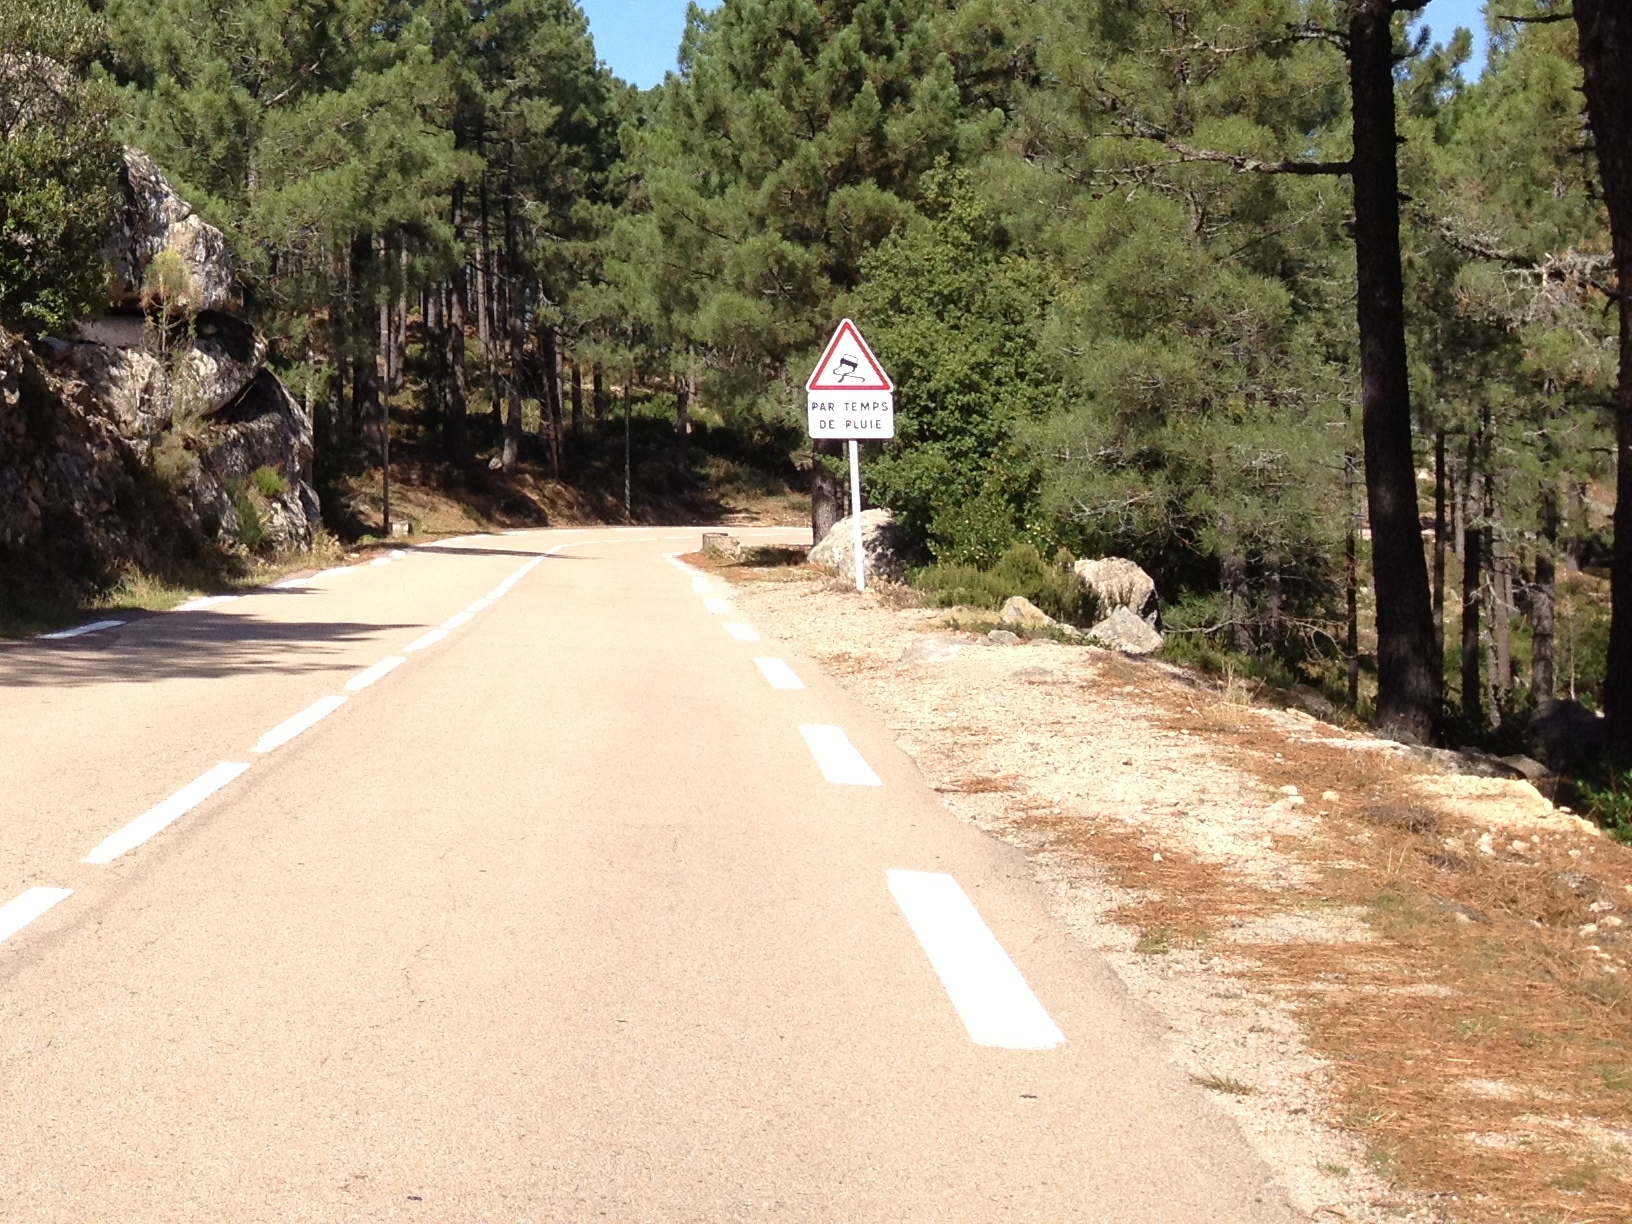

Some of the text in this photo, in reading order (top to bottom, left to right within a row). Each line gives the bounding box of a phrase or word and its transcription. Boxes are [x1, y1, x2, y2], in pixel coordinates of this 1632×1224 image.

[811, 402, 889, 411] PAR TEMPS
[819, 419, 882, 429] DE PLUIE
